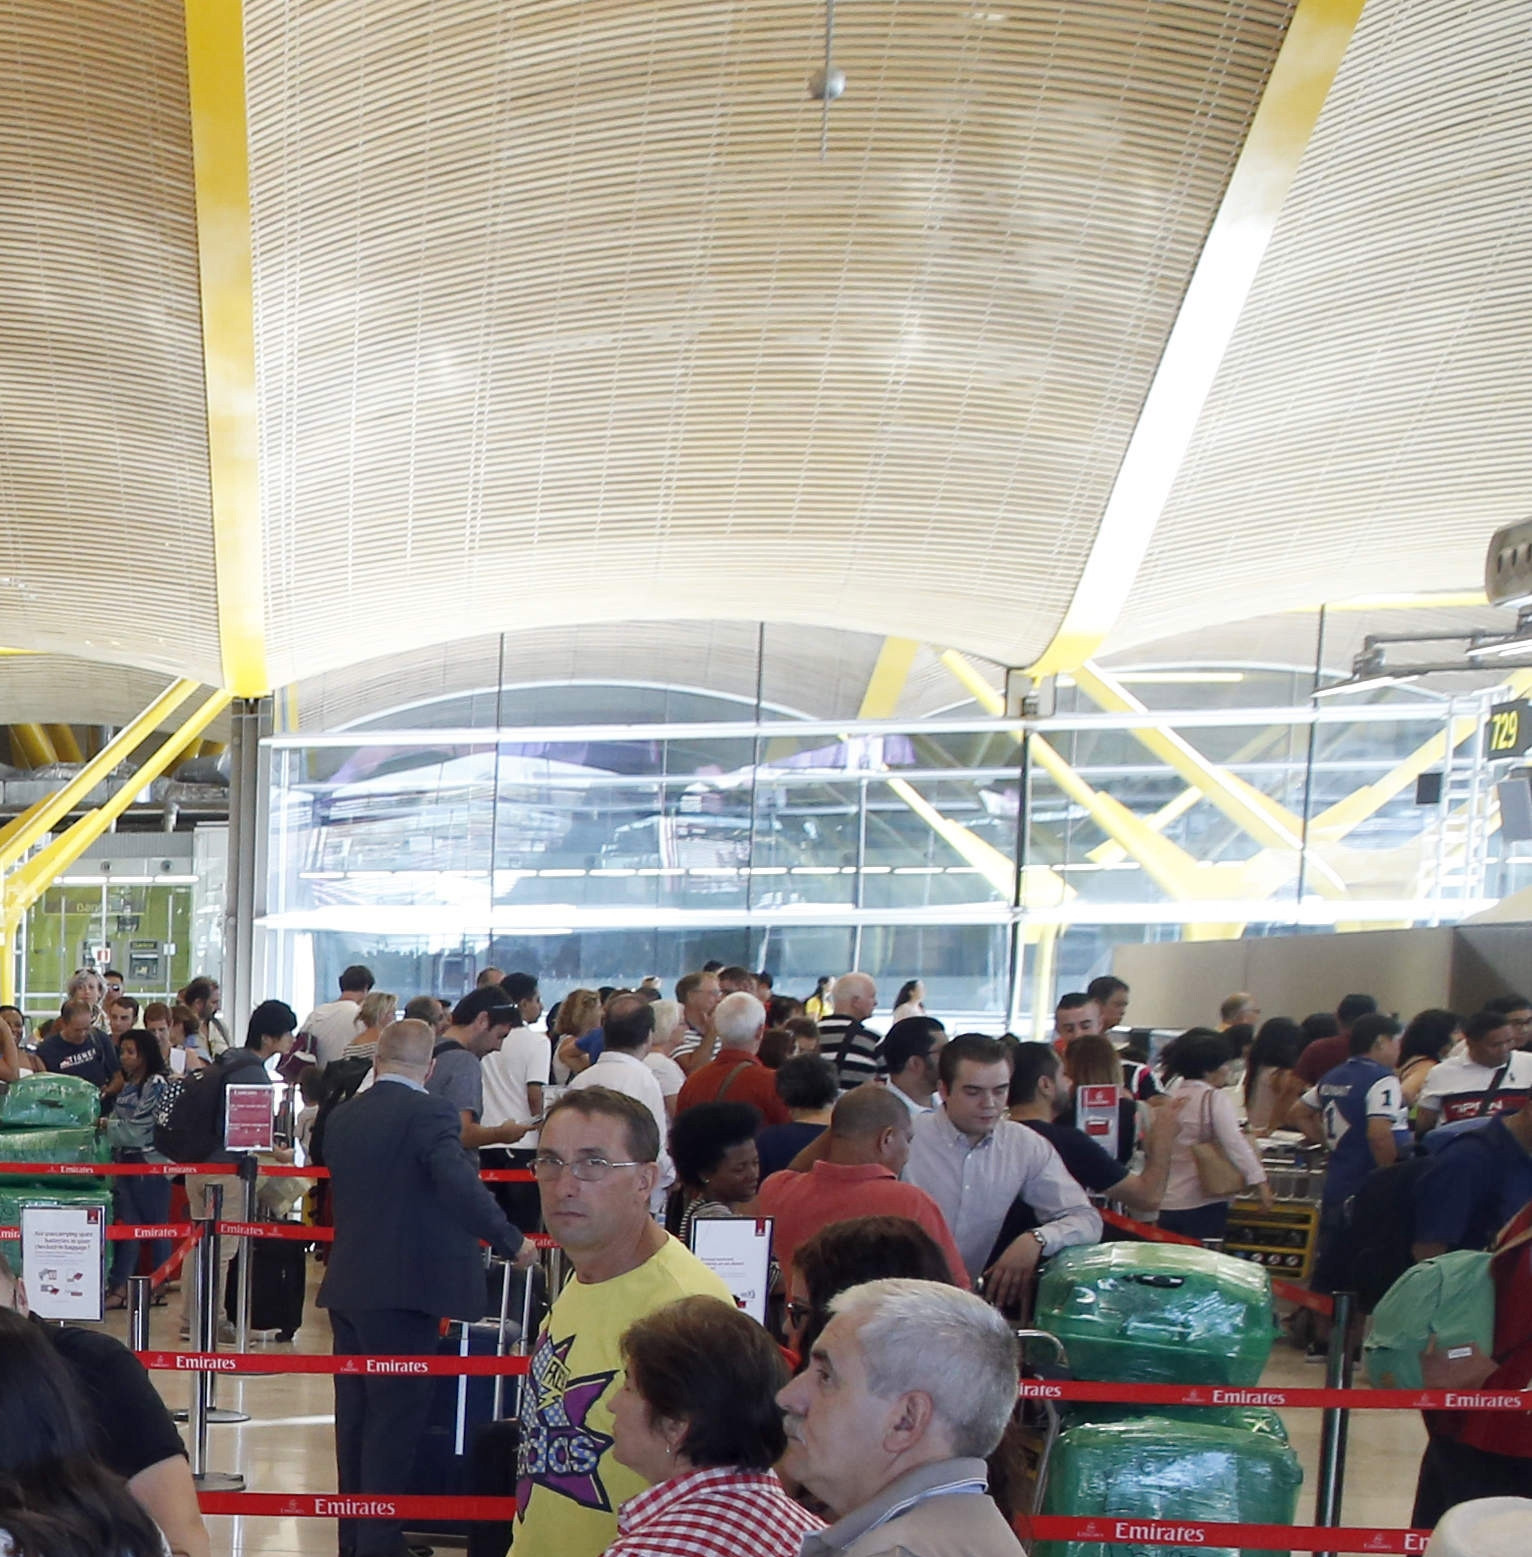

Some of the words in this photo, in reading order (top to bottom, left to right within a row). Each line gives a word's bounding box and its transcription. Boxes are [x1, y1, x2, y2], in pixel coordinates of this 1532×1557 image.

[1491, 711, 1520, 749] 729
[60, 1165, 94, 1175] Emirates
[163, 1165, 197, 1175] Emirates
[134, 1227, 178, 1239] Emirates
[220, 1223, 265, 1236] Emirates
[176, 1355, 236, 1369] Emirates
[366, 1359, 429, 1373] Emirates
[1212, 1389, 1286, 1406] Emirates
[1444, 1392, 1523, 1408] Emirates
[314, 1498, 396, 1516] Emirates
[1115, 1522, 1206, 1543] Emirates
